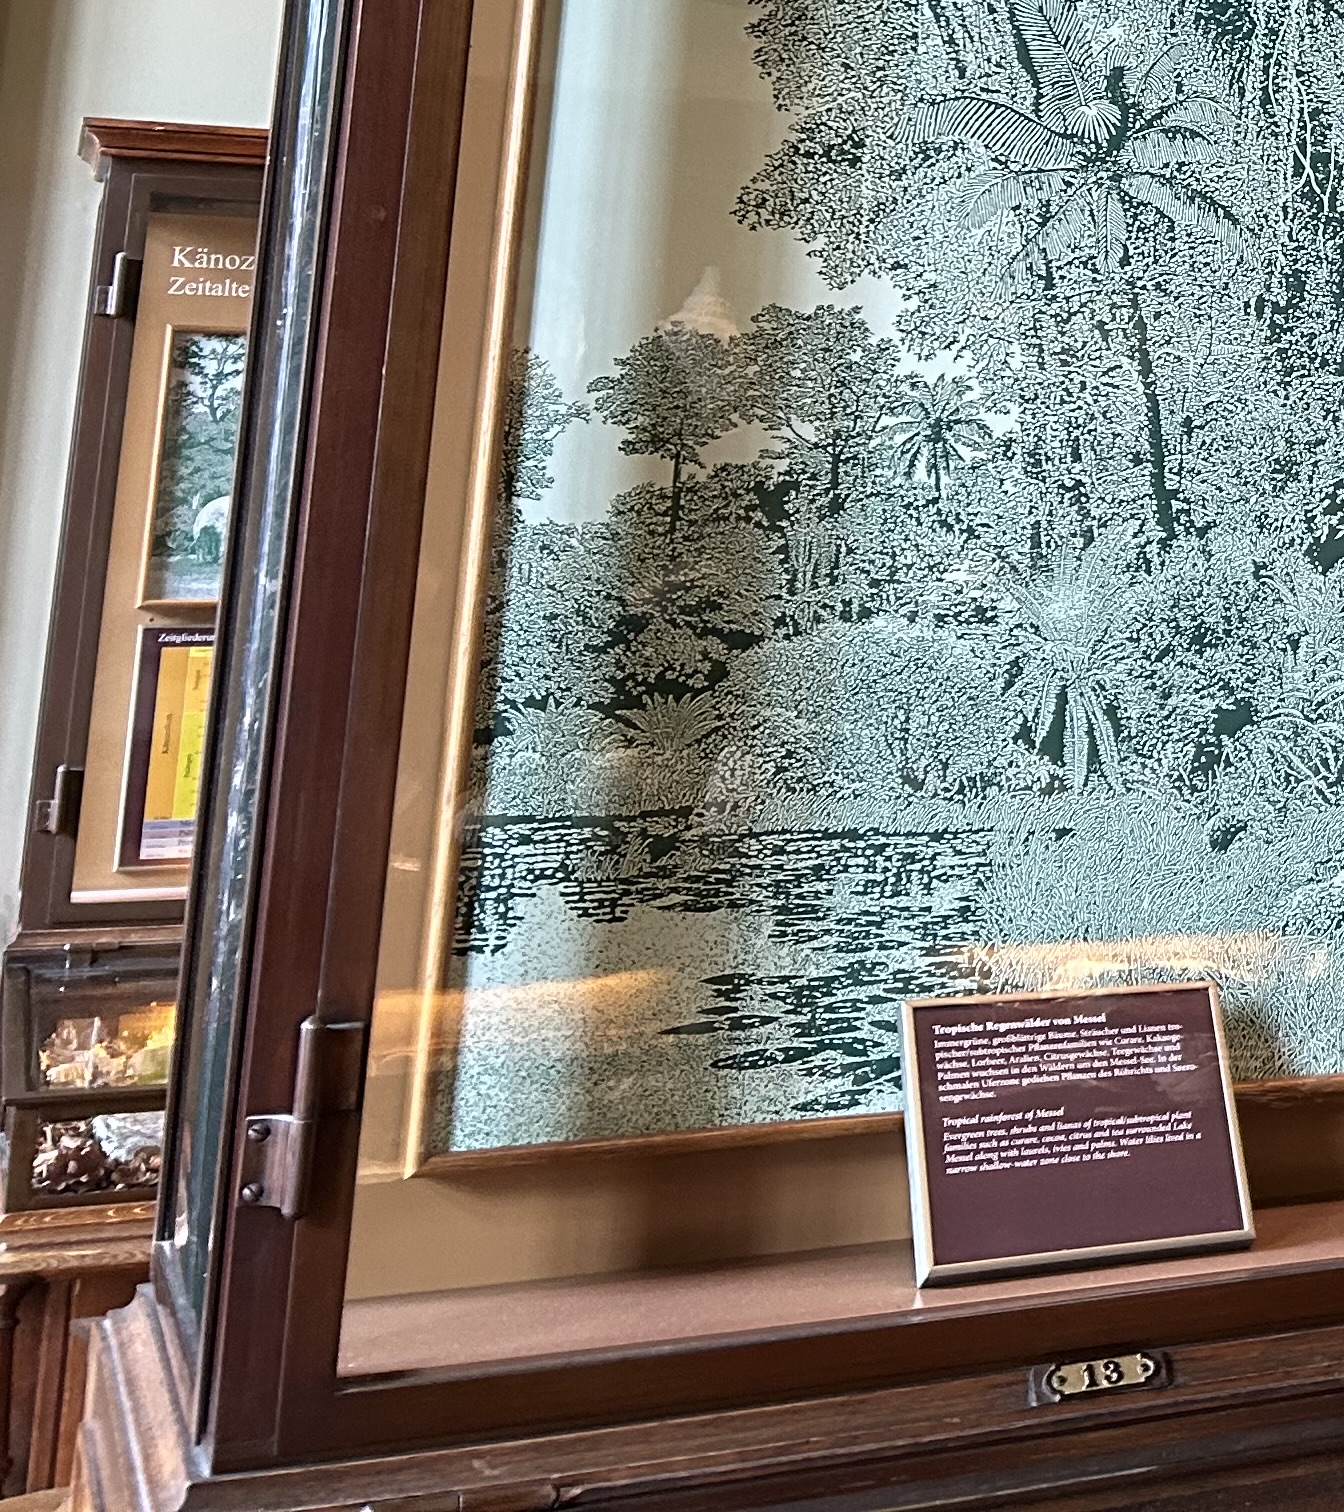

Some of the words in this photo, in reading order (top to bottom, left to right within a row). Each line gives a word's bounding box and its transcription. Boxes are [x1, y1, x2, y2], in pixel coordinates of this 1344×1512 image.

[932, 1023, 984, 1036] Tropische
[1073, 1014, 1106, 1024] Messel
[1120, 1026, 1137, 1034] und
[1098, 1038, 1113, 1046] wie
[1164, 1043, 1181, 1051] und
[937, 1071, 970, 1080] Palmen
[1154, 1065, 1171, 1073] und
[942, 1115, 980, 1129] Tropical
[980, 1111, 1023, 1125] rainforest
[1024, 1110, 1035, 1122] of
[1035, 1107, 1065, 1118] Messel
[943, 1132, 985, 1142] Evergreen
[1038, 1123, 1056, 1132] and
[1082, 1119, 1093, 1130] of
[1170, 1110, 1192, 1122] plant
[978, 1139, 998, 1148] such
[1093, 1128, 1110, 1138] and
[1172, 1121, 1193, 1130] Lake
[944, 1152, 974, 1163] Messel
[974, 1152, 999, 1161] along
[1000, 1148, 1020, 1158] with
[1072, 1142, 1089, 1151] and
[1120, 1137, 1144, 1146] Water
[1186, 1132, 1194, 1140] in
[1060, 1154, 1080, 1163] close
[1082, 1152, 1091, 1161] to
[1092, 1151, 1106, 1160] the
[1082, 1360, 1124, 1388] 13
